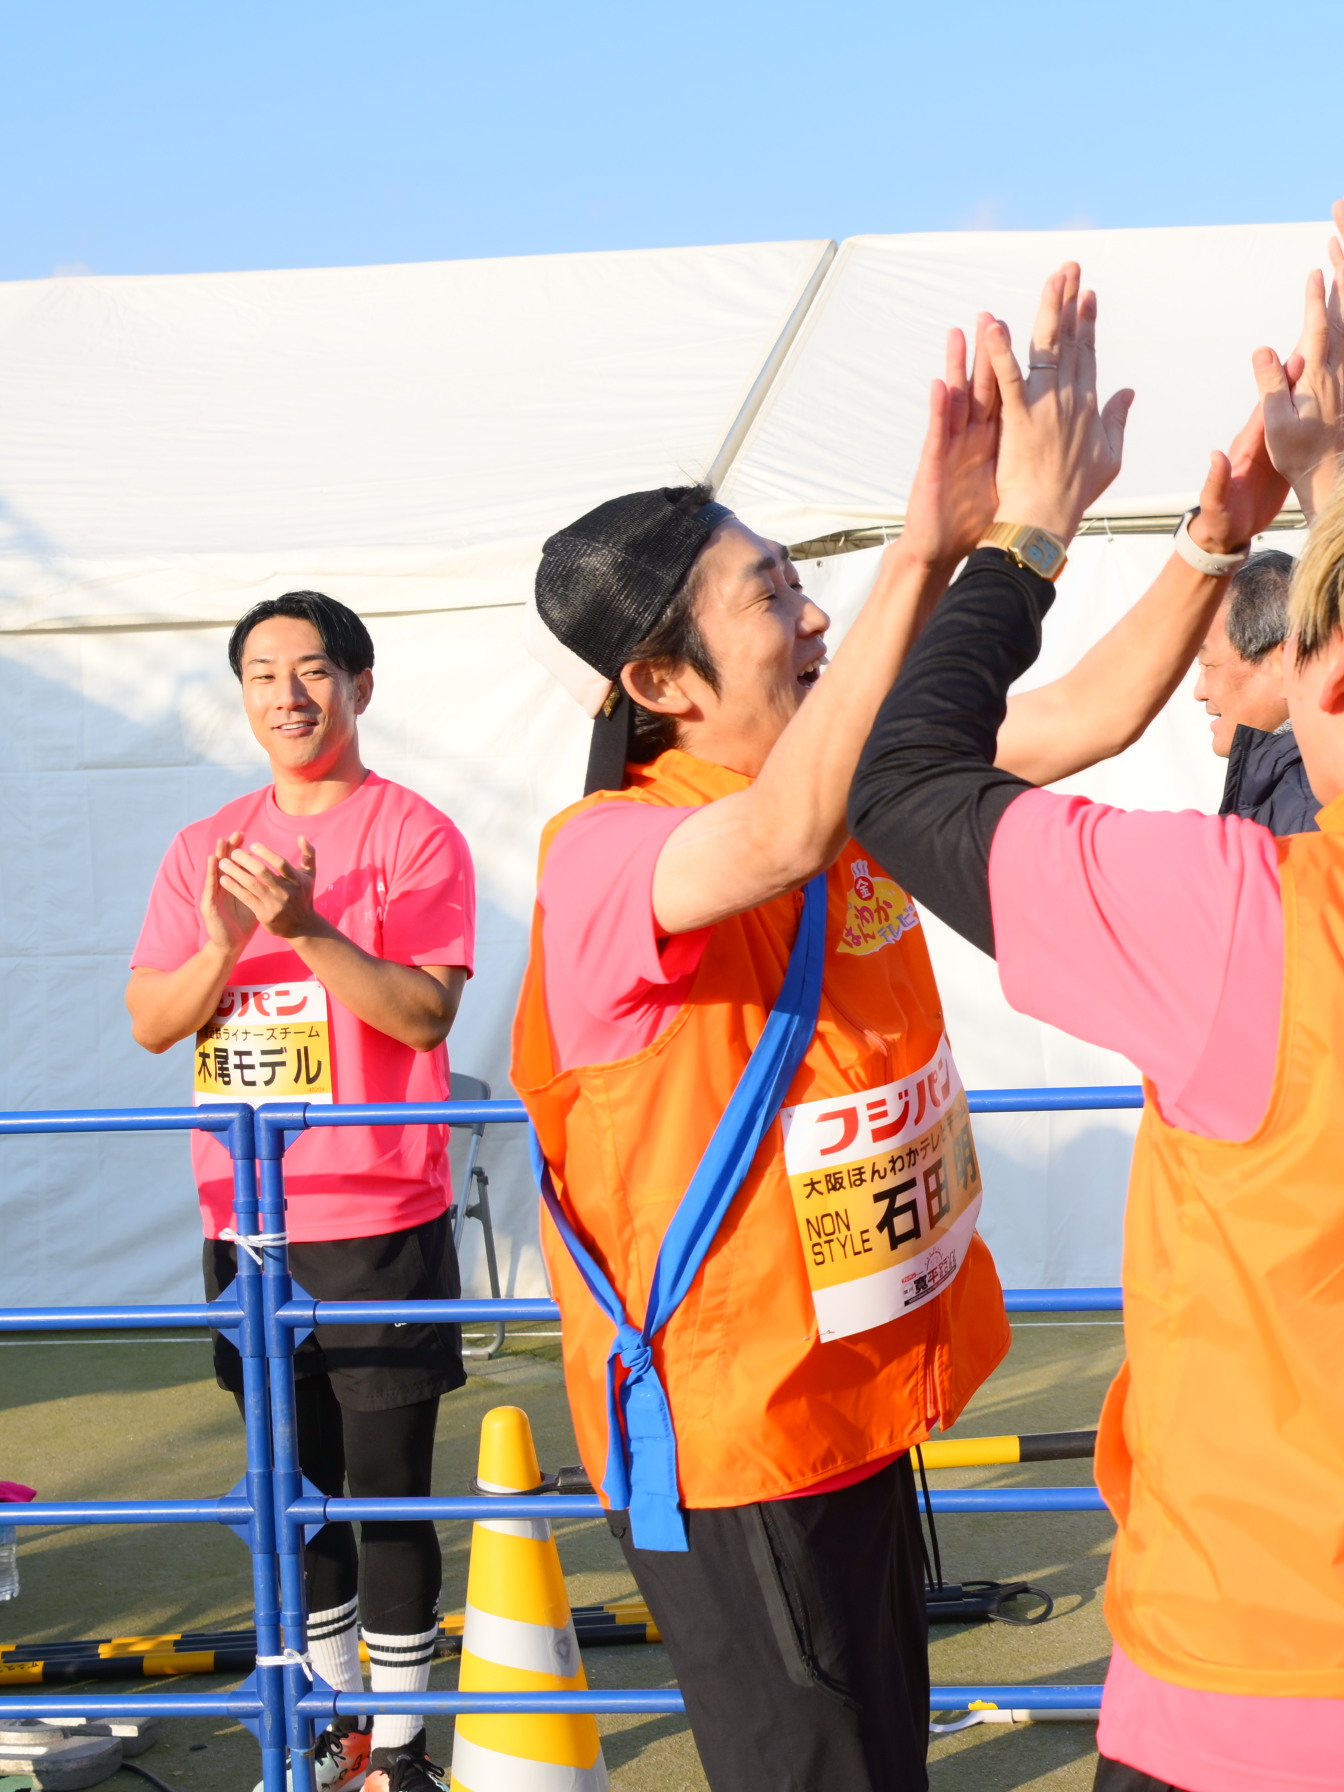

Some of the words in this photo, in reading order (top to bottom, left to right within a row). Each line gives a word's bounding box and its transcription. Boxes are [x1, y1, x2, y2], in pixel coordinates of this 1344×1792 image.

[855, 878, 872, 899] 金
[815, 1058, 950, 1157] フジパン
[805, 1208, 851, 1242] NON
[811, 1229, 873, 1267] STYLE
